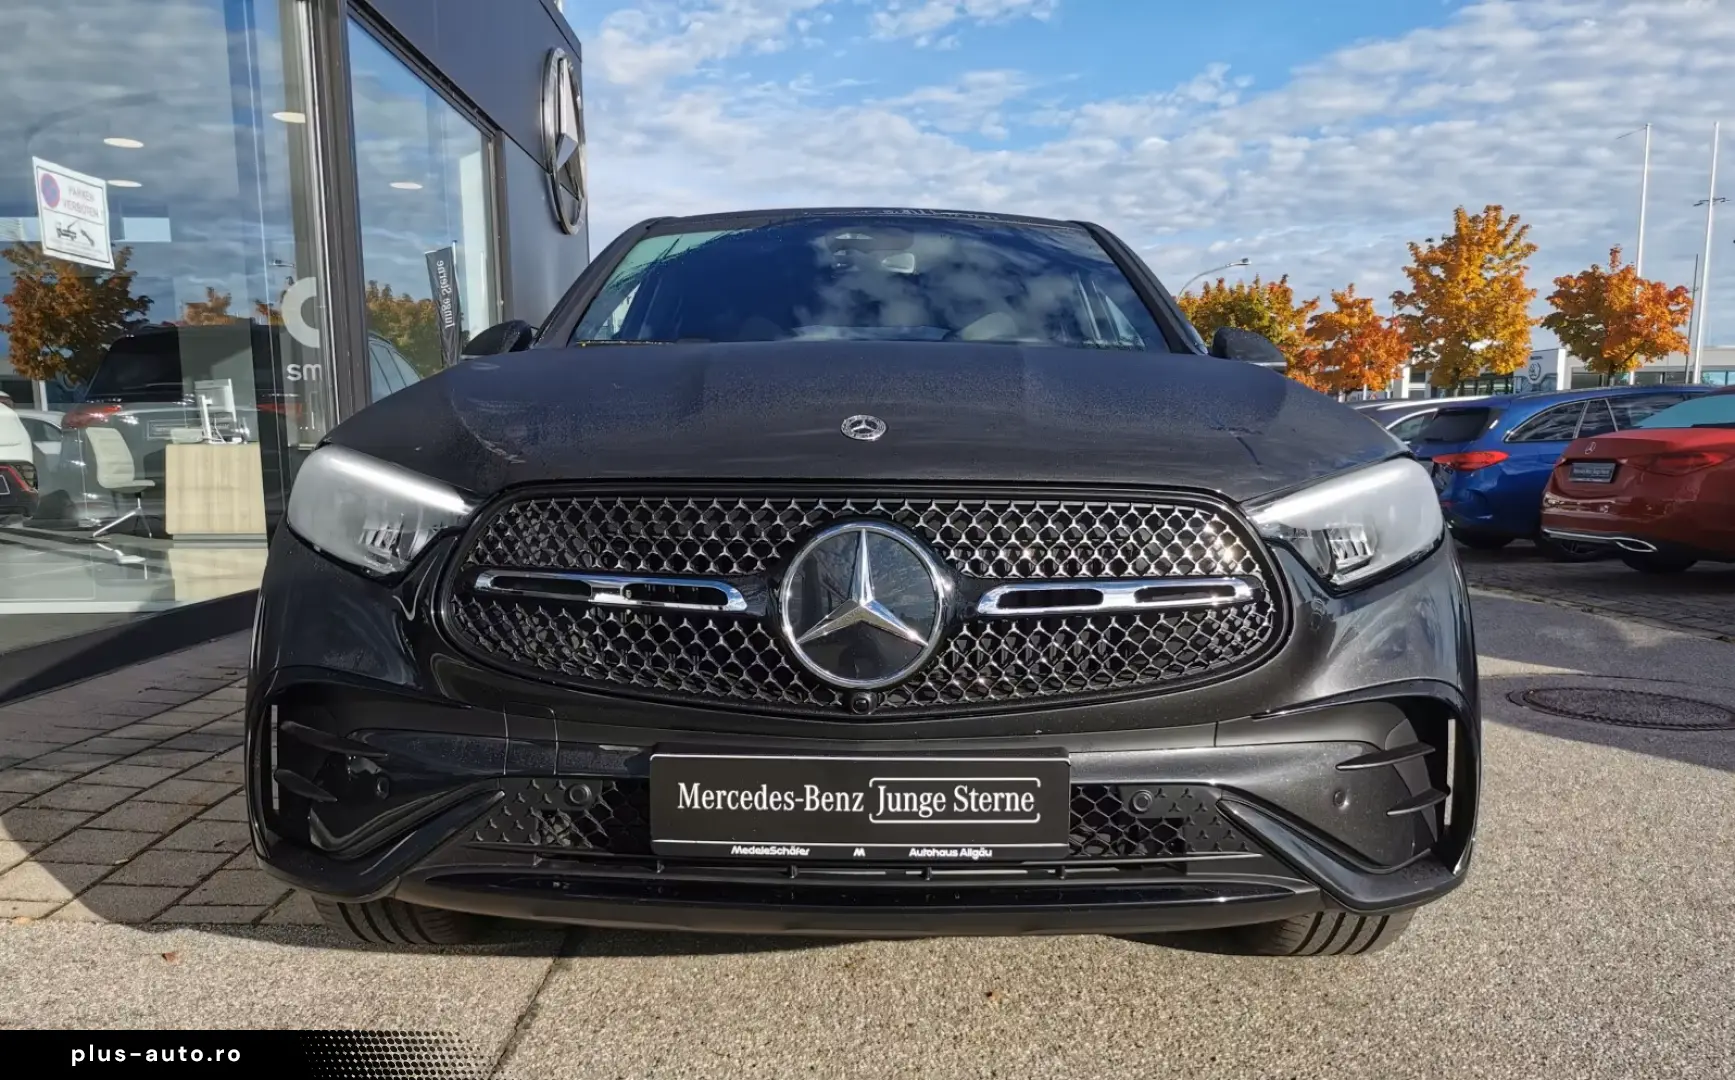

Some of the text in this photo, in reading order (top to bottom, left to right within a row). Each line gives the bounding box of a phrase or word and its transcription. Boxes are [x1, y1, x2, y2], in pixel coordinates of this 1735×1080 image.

[677, 782, 1034, 817] Mercedes-Benz Junge Sterne
[731, 845, 810, 856] MedeleSchäfer
[908, 847, 993, 860] Autohaus Allgäu
